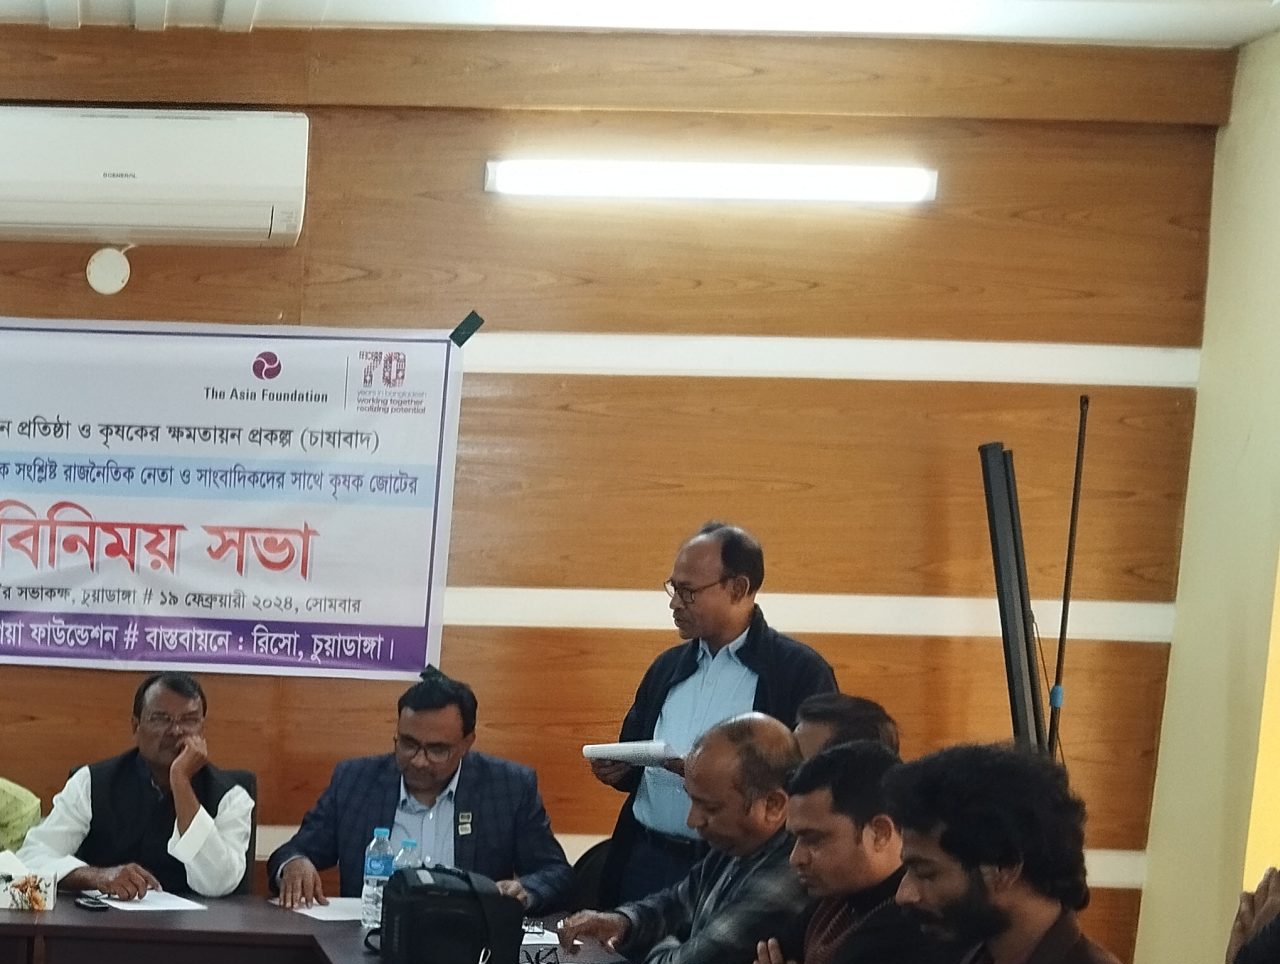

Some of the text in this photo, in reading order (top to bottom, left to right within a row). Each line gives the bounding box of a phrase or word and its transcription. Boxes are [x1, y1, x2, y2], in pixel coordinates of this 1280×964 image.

[204, 387, 329, 404] The Asia Foundation
[17, 414, 72, 441] প্রতিষ্ঠা
[77, 423, 91, 439] ও
[98, 423, 160, 448] কৃষকের
[167, 425, 244, 447] ক্ষমতায়ন
[248, 426, 294, 447] প্রকল্প
[14, 456, 58, 484] সংশ্লিষ্ট
[63, 457, 136, 484] রাজনৈতিক
[140, 465, 174, 486] নেতা
[179, 469, 191, 486] ও
[196, 463, 286, 490] সাংবাদিকদের
[291, 469, 323, 491] সাথে
[329, 474, 365, 499] কৃষক
[369, 470, 419, 496] জোটের
[202, 520, 321, 582] সভা
[81, 587, 138, 607] চুয়াডাঙ্গা
[159, 590, 179, 606] ১৯
[252, 595, 300, 614] ২০২৪,
[305, 595, 363, 614] সোমবার
[29, 617, 120, 651] ফাউন্ডেশন
[123, 623, 139, 652] #
[144, 624, 233, 654] বাস্তবায়নে
[250, 623, 304, 662] রিসো,
